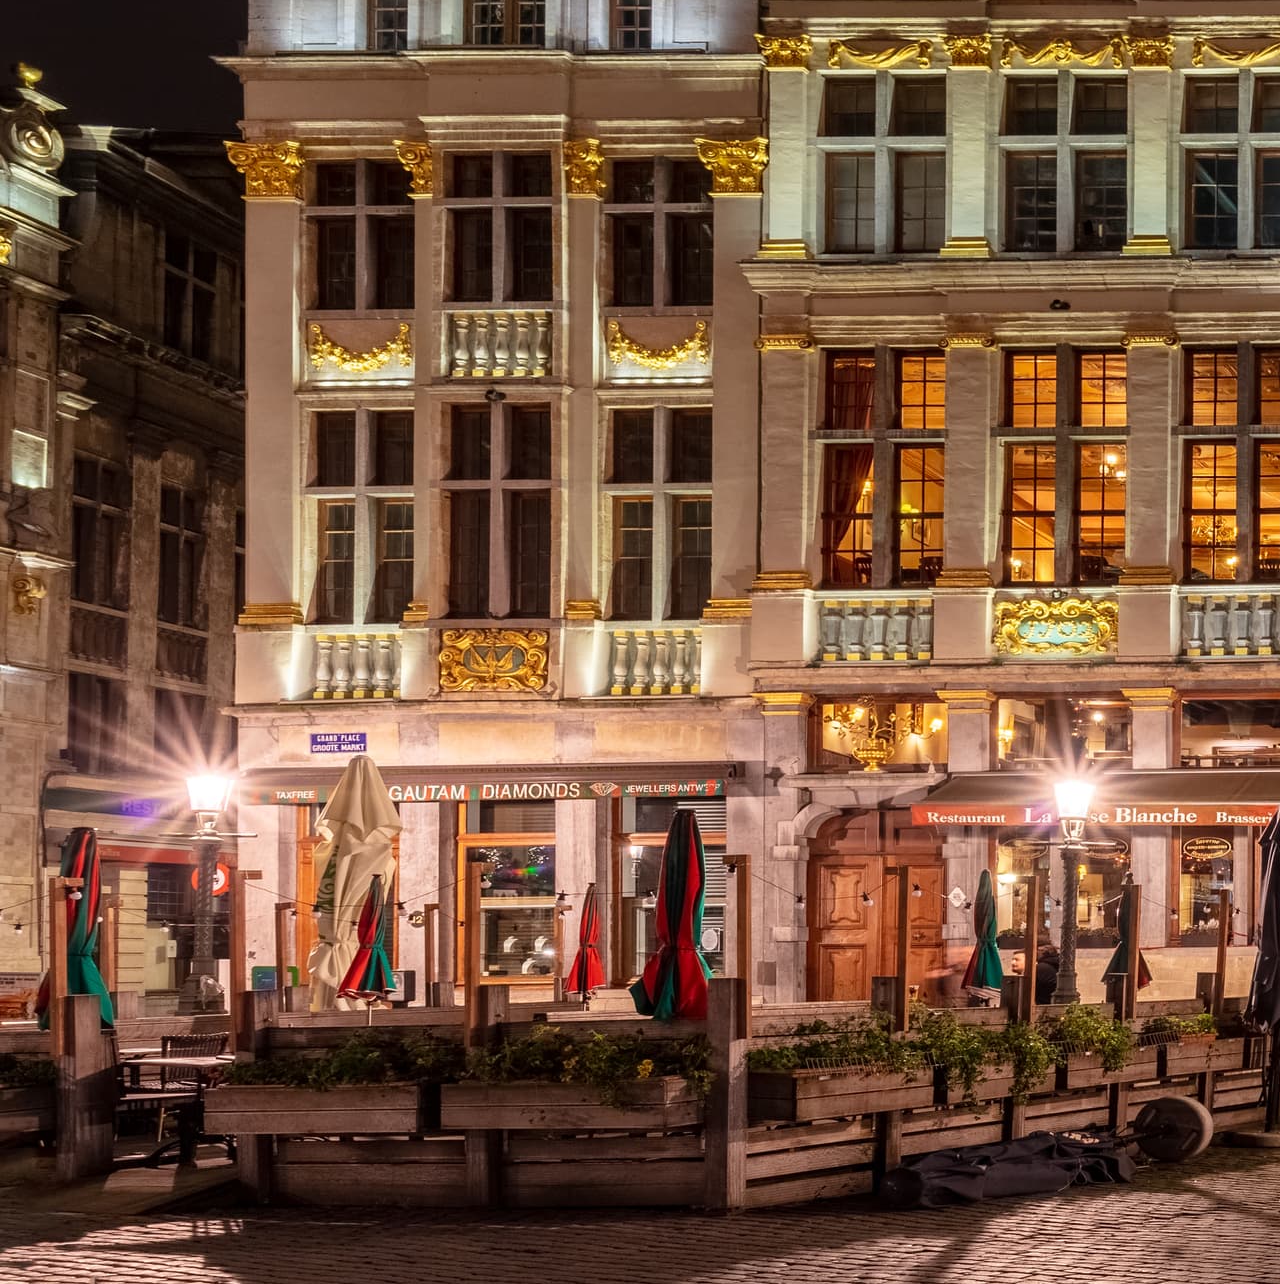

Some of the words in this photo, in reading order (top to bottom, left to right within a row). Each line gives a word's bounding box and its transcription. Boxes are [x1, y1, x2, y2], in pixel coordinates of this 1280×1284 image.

[312, 744, 339, 752] GROOTE
[340, 743, 365, 751] MARKT
[275, 790, 315, 799] TAXFREE
[388, 784, 465, 801] GAUTAM
[482, 783, 580, 799] DIAMONDS
[625, 784, 676, 794] JEWELLERS
[926, 811, 1006, 824] Restaurant
[1023, 807, 1052, 824] La
[1115, 807, 1198, 824] Blanche
[1216, 811, 1272, 824] Brasseri
